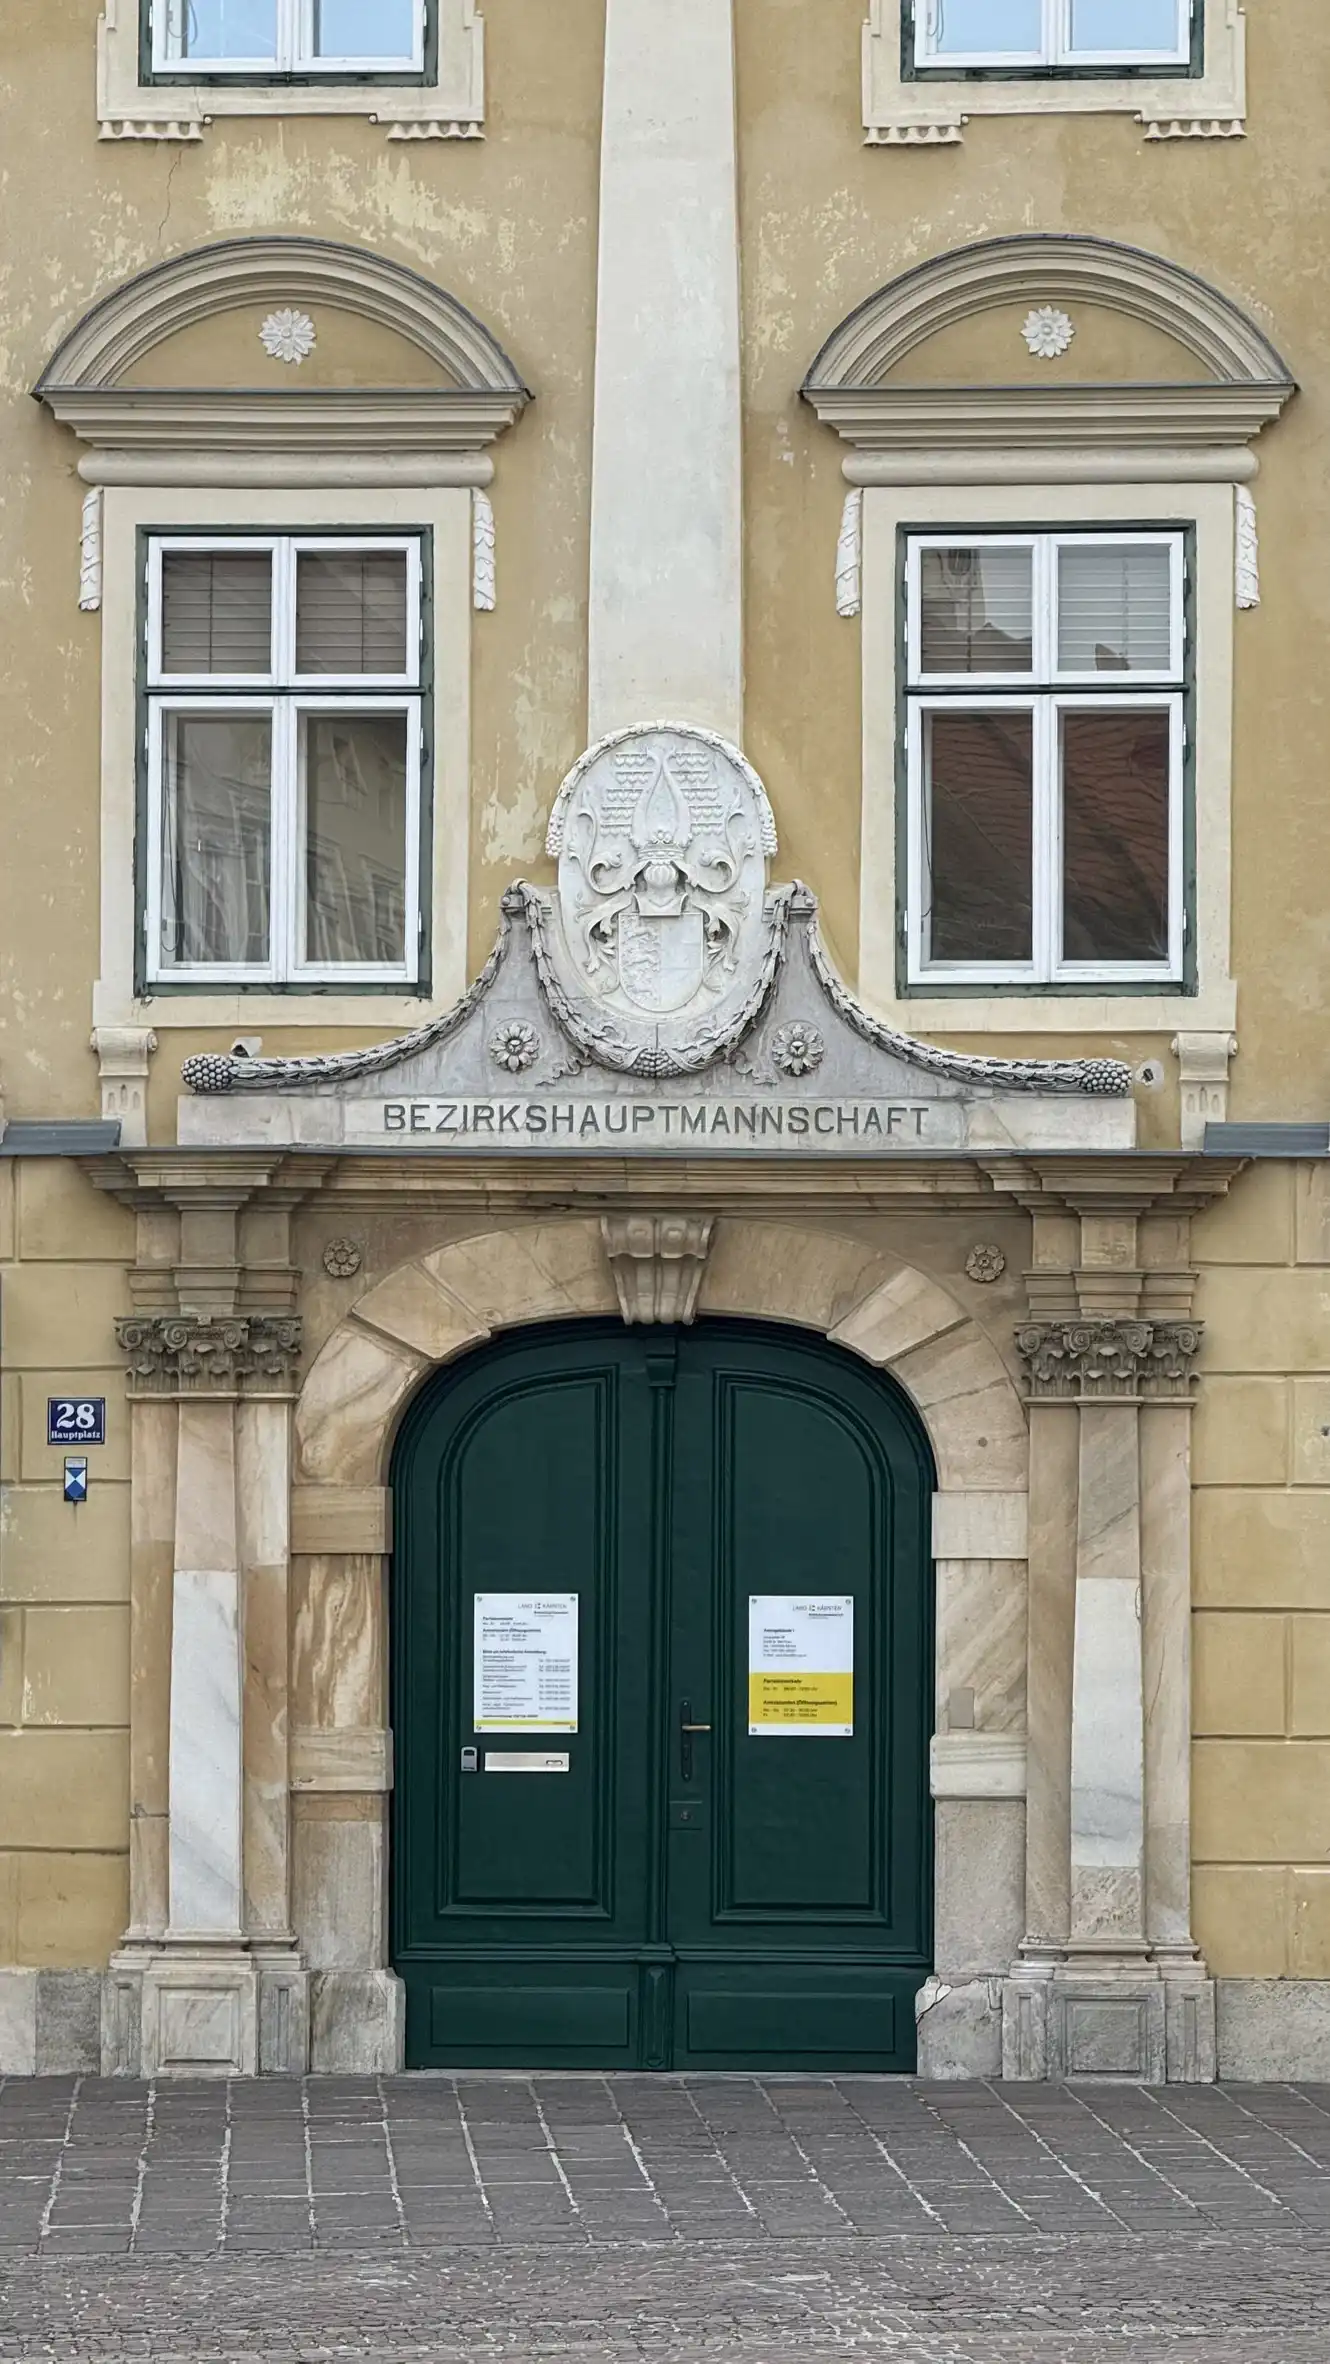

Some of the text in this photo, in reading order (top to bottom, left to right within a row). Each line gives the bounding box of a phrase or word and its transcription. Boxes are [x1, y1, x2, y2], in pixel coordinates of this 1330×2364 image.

[383, 1103, 929, 1134] BEZIRKSHAUPTMANNSCHAFT
[56, 1403, 95, 1429] 28
[51, 1430, 101, 1441] Hauptplatz
